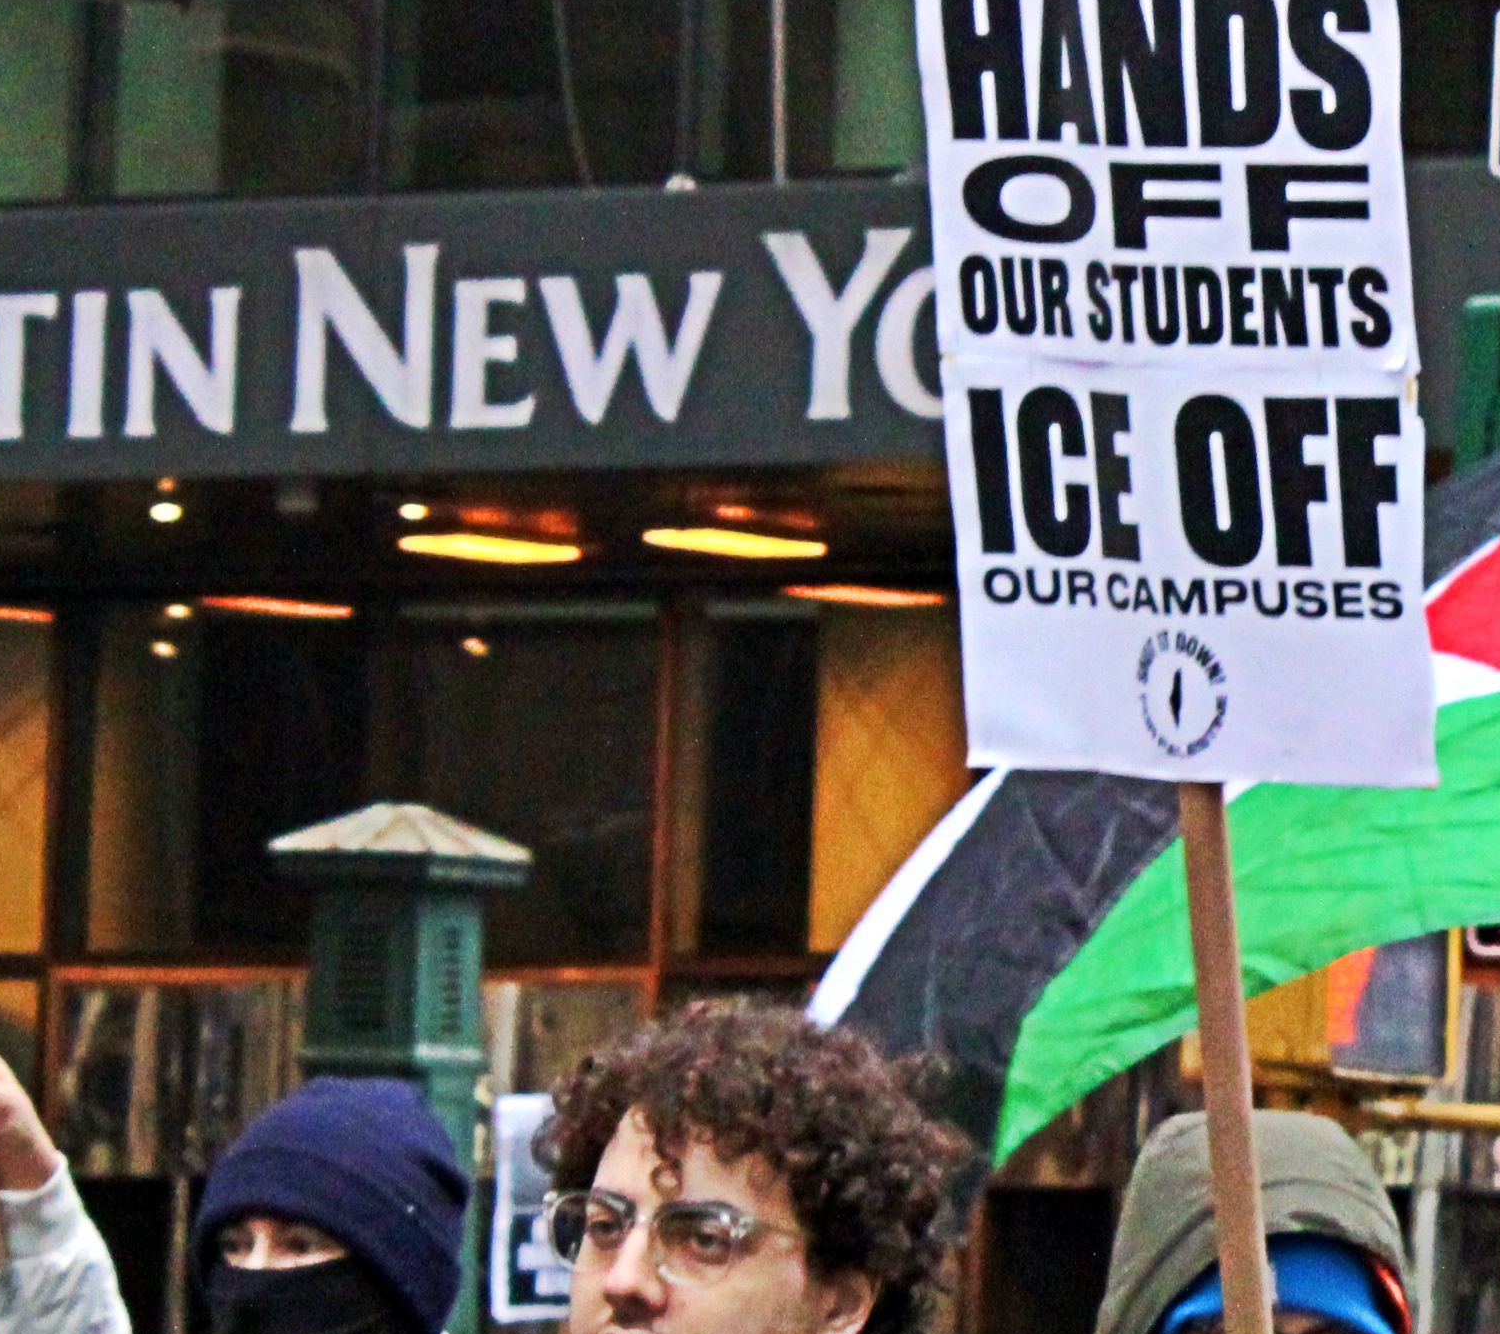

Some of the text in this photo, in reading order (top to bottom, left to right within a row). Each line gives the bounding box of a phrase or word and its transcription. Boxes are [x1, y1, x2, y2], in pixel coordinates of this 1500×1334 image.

[962, 154, 1370, 252] OFF
[959, 254, 1392, 349] OUR STUDENTS
[967, 384, 1402, 569] ICE OFF
[982, 566, 1404, 620] OUR CAMPUSES
